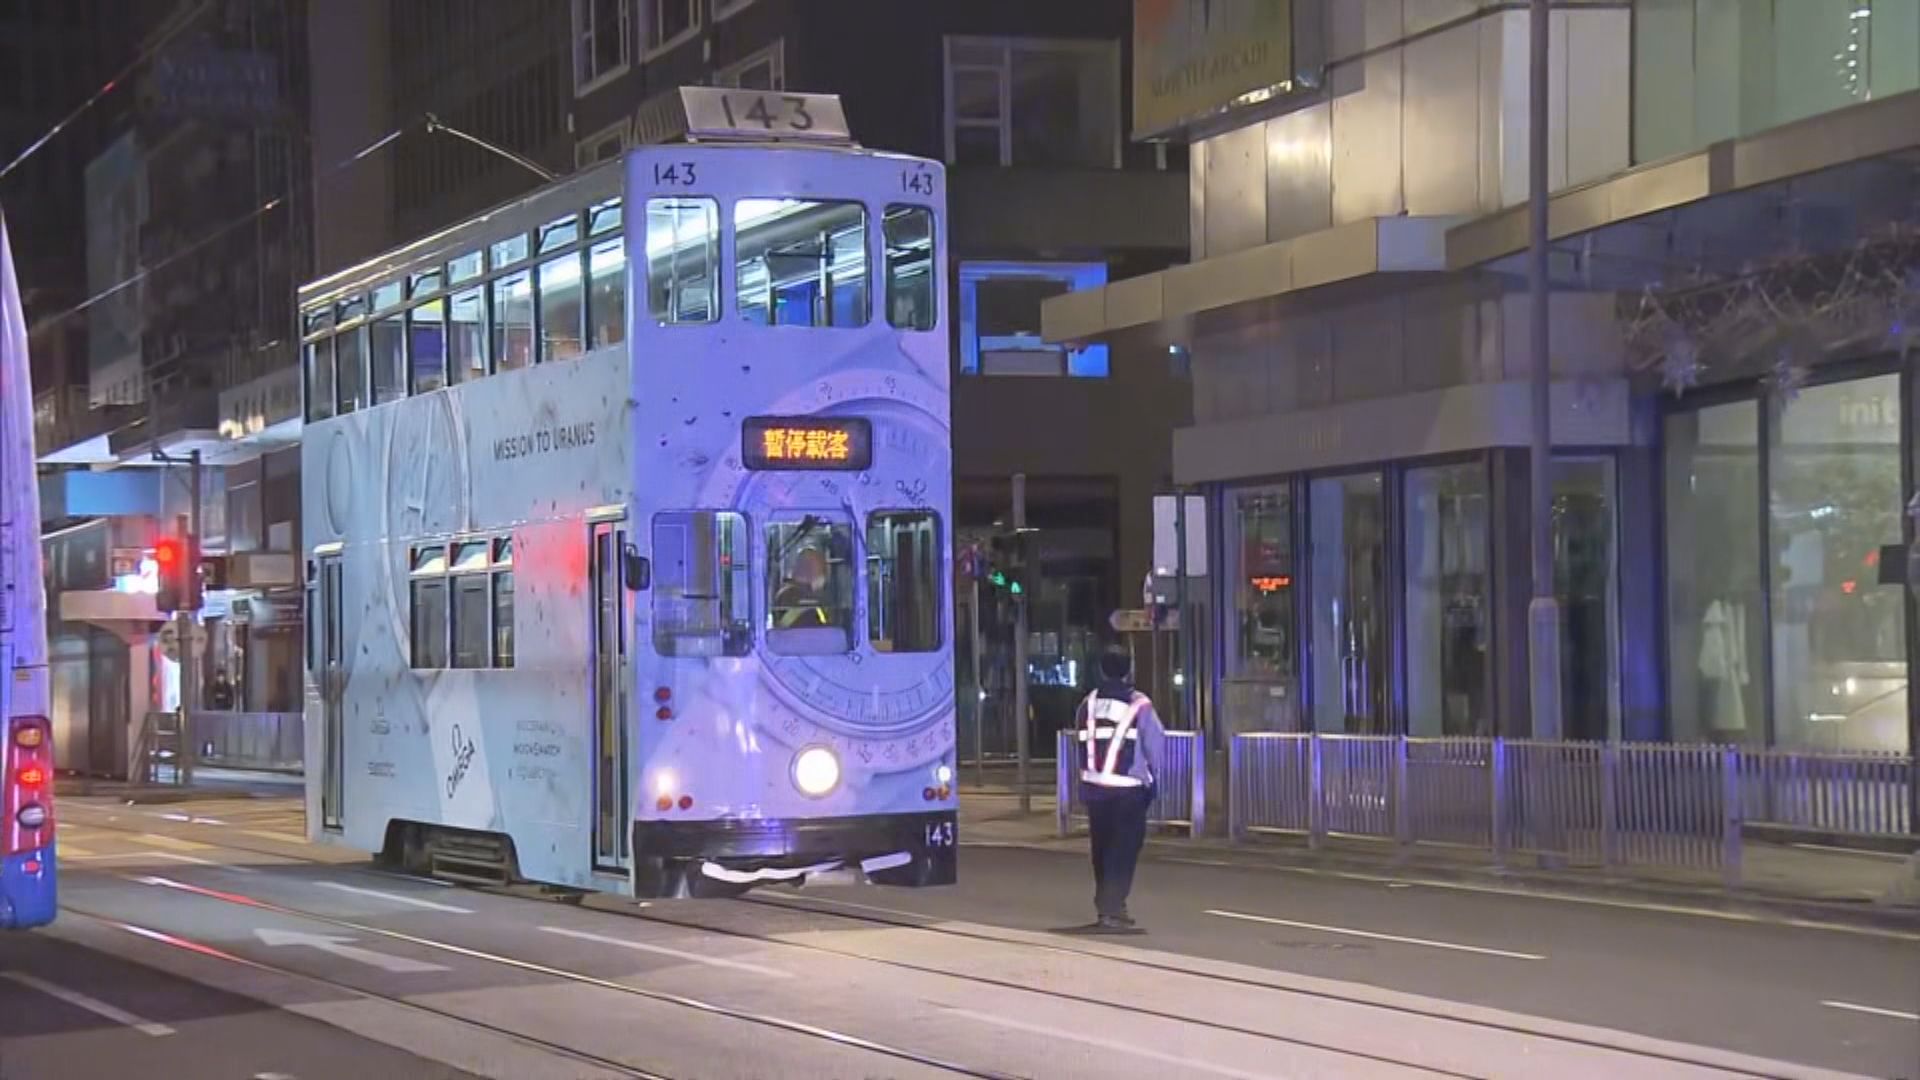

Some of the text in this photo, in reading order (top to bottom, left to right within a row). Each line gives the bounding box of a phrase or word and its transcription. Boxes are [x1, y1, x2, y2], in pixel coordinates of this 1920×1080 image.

[721, 95, 813, 130] 143
[653, 162, 696, 186] 143
[901, 171, 934, 196] 143
[493, 421, 595, 461] MISSION TO URANUS
[764, 428, 849, 460] 暫停載客
[925, 822, 953, 847] 143
